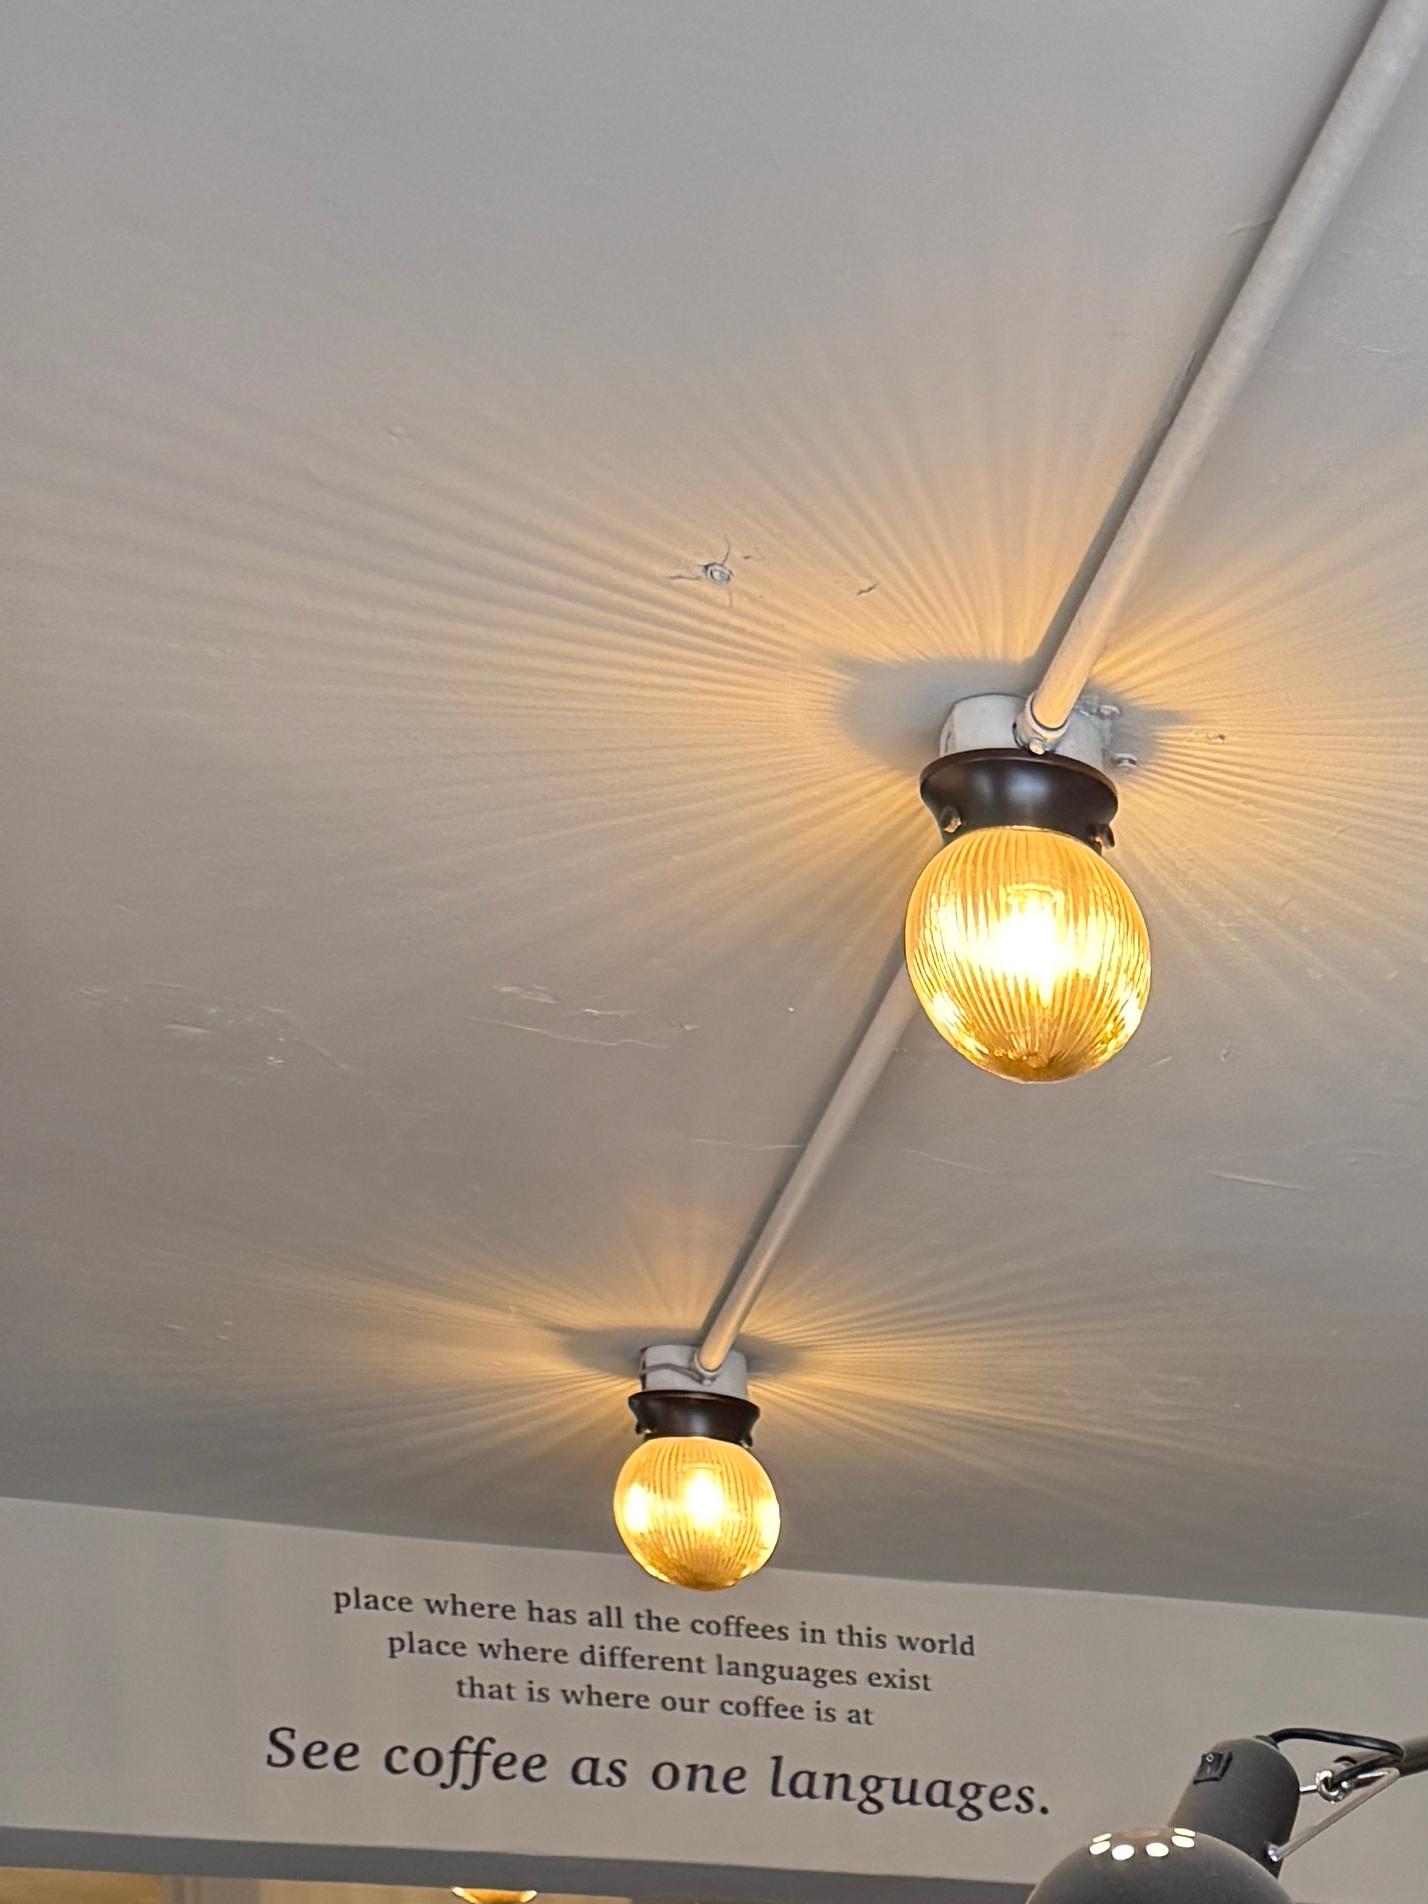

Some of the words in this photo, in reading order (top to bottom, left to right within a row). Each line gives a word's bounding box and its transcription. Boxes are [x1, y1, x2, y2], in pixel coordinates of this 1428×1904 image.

[332, 1586, 414, 1615] place
[422, 1592, 517, 1621] where
[525, 1599, 578, 1626] has
[587, 1604, 625, 1630] all
[633, 1608, 681, 1633] the
[689, 1612, 790, 1642] coffees
[799, 1620, 827, 1645] in
[835, 1623, 888, 1650] this
[895, 1632, 976, 1657] world
[387, 1630, 468, 1660] place
[476, 1637, 570, 1665] where
[578, 1643, 707, 1675] different
[715, 1652, 858, 1689] languages
[865, 1667, 933, 1692] exist
[455, 1675, 517, 1702] that
[526, 1679, 551, 1704] is
[559, 1683, 651, 1710] where
[660, 1695, 711, 1714] our
[718, 1694, 806, 1721] coffee
[813, 1699, 837, 1724] is
[845, 1707, 875, 1727] at
[265, 1726, 360, 1773] See
[383, 1734, 548, 1792] coffee
[570, 1756, 628, 1789] as
[650, 1761, 748, 1796] one
[769, 1754, 1050, 1822] languages.
